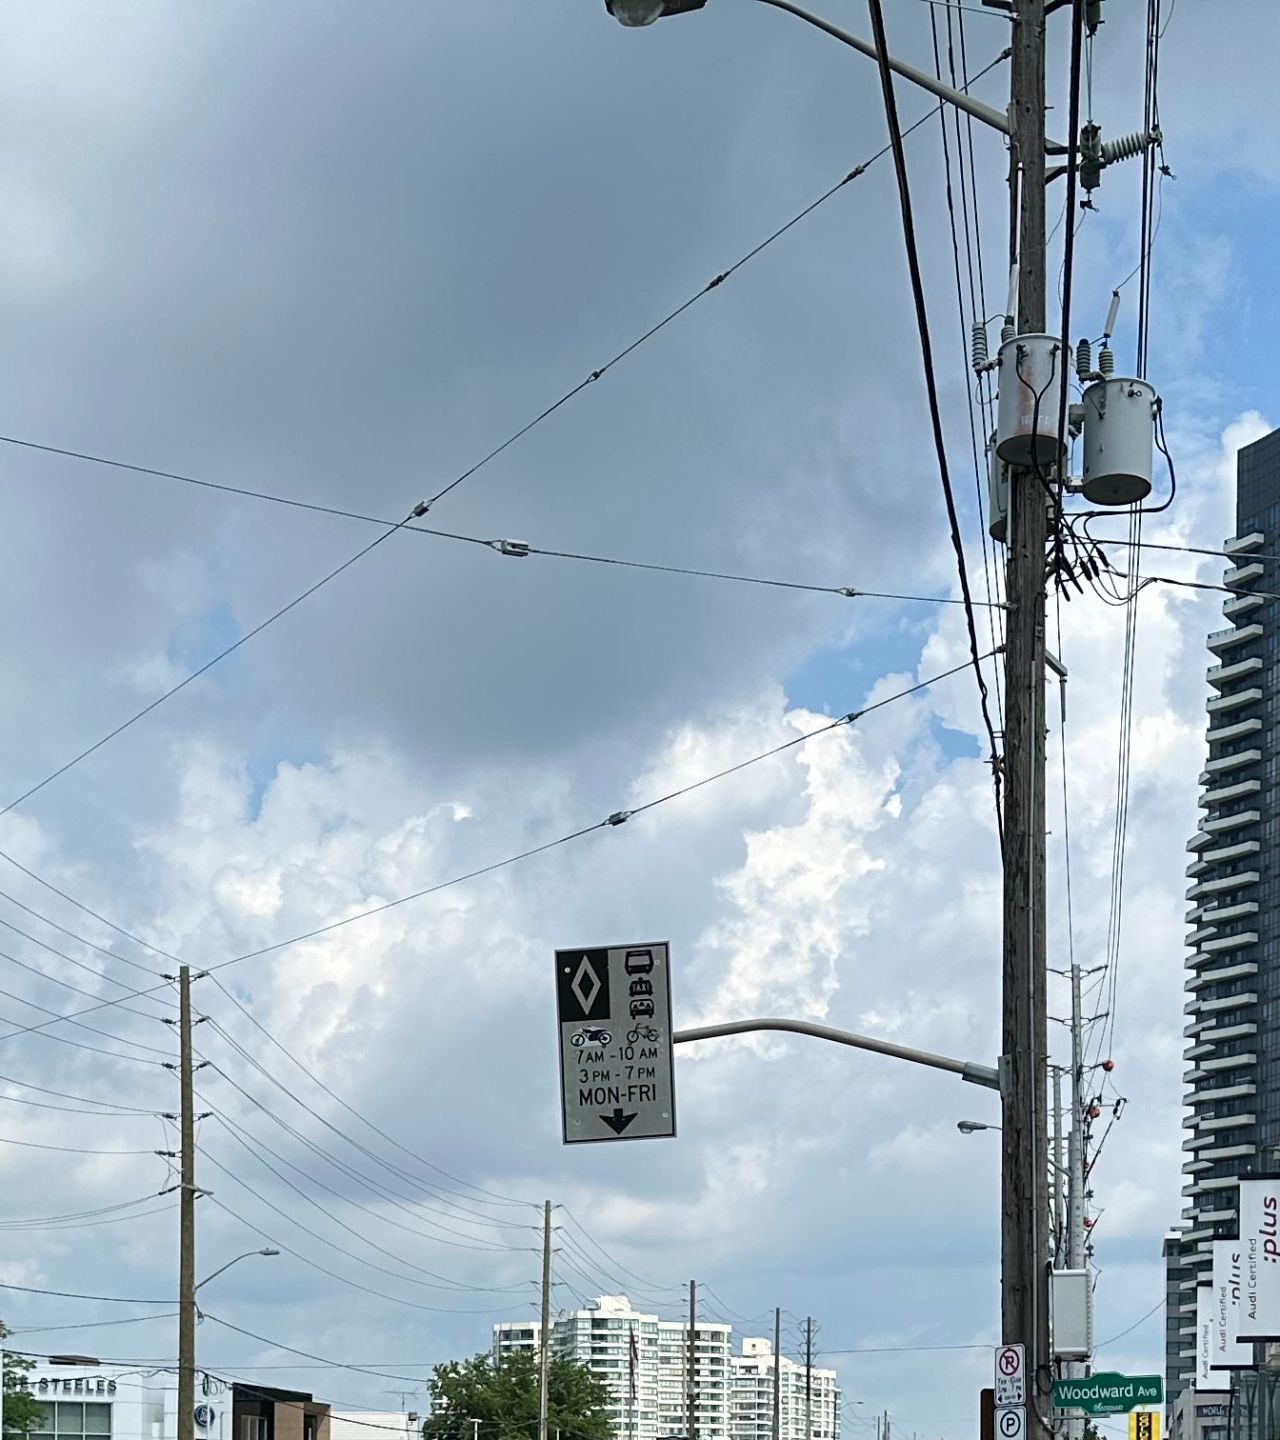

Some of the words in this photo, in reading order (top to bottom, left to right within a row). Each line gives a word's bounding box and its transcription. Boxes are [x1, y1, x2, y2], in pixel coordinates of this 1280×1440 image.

[632, 982, 650, 992] TAXI
[639, 1047, 658, 1060] AM
[579, 1083, 656, 1106] MON-FRI
[1247, 1238, 1257, 1288] Certified
[1247, 1291, 1257, 1320] Audi
[1219, 1332, 1227, 1352] Audi
[1059, 1384, 1133, 1399] Woodward
[1138, 1386, 1157, 1397] Ave
